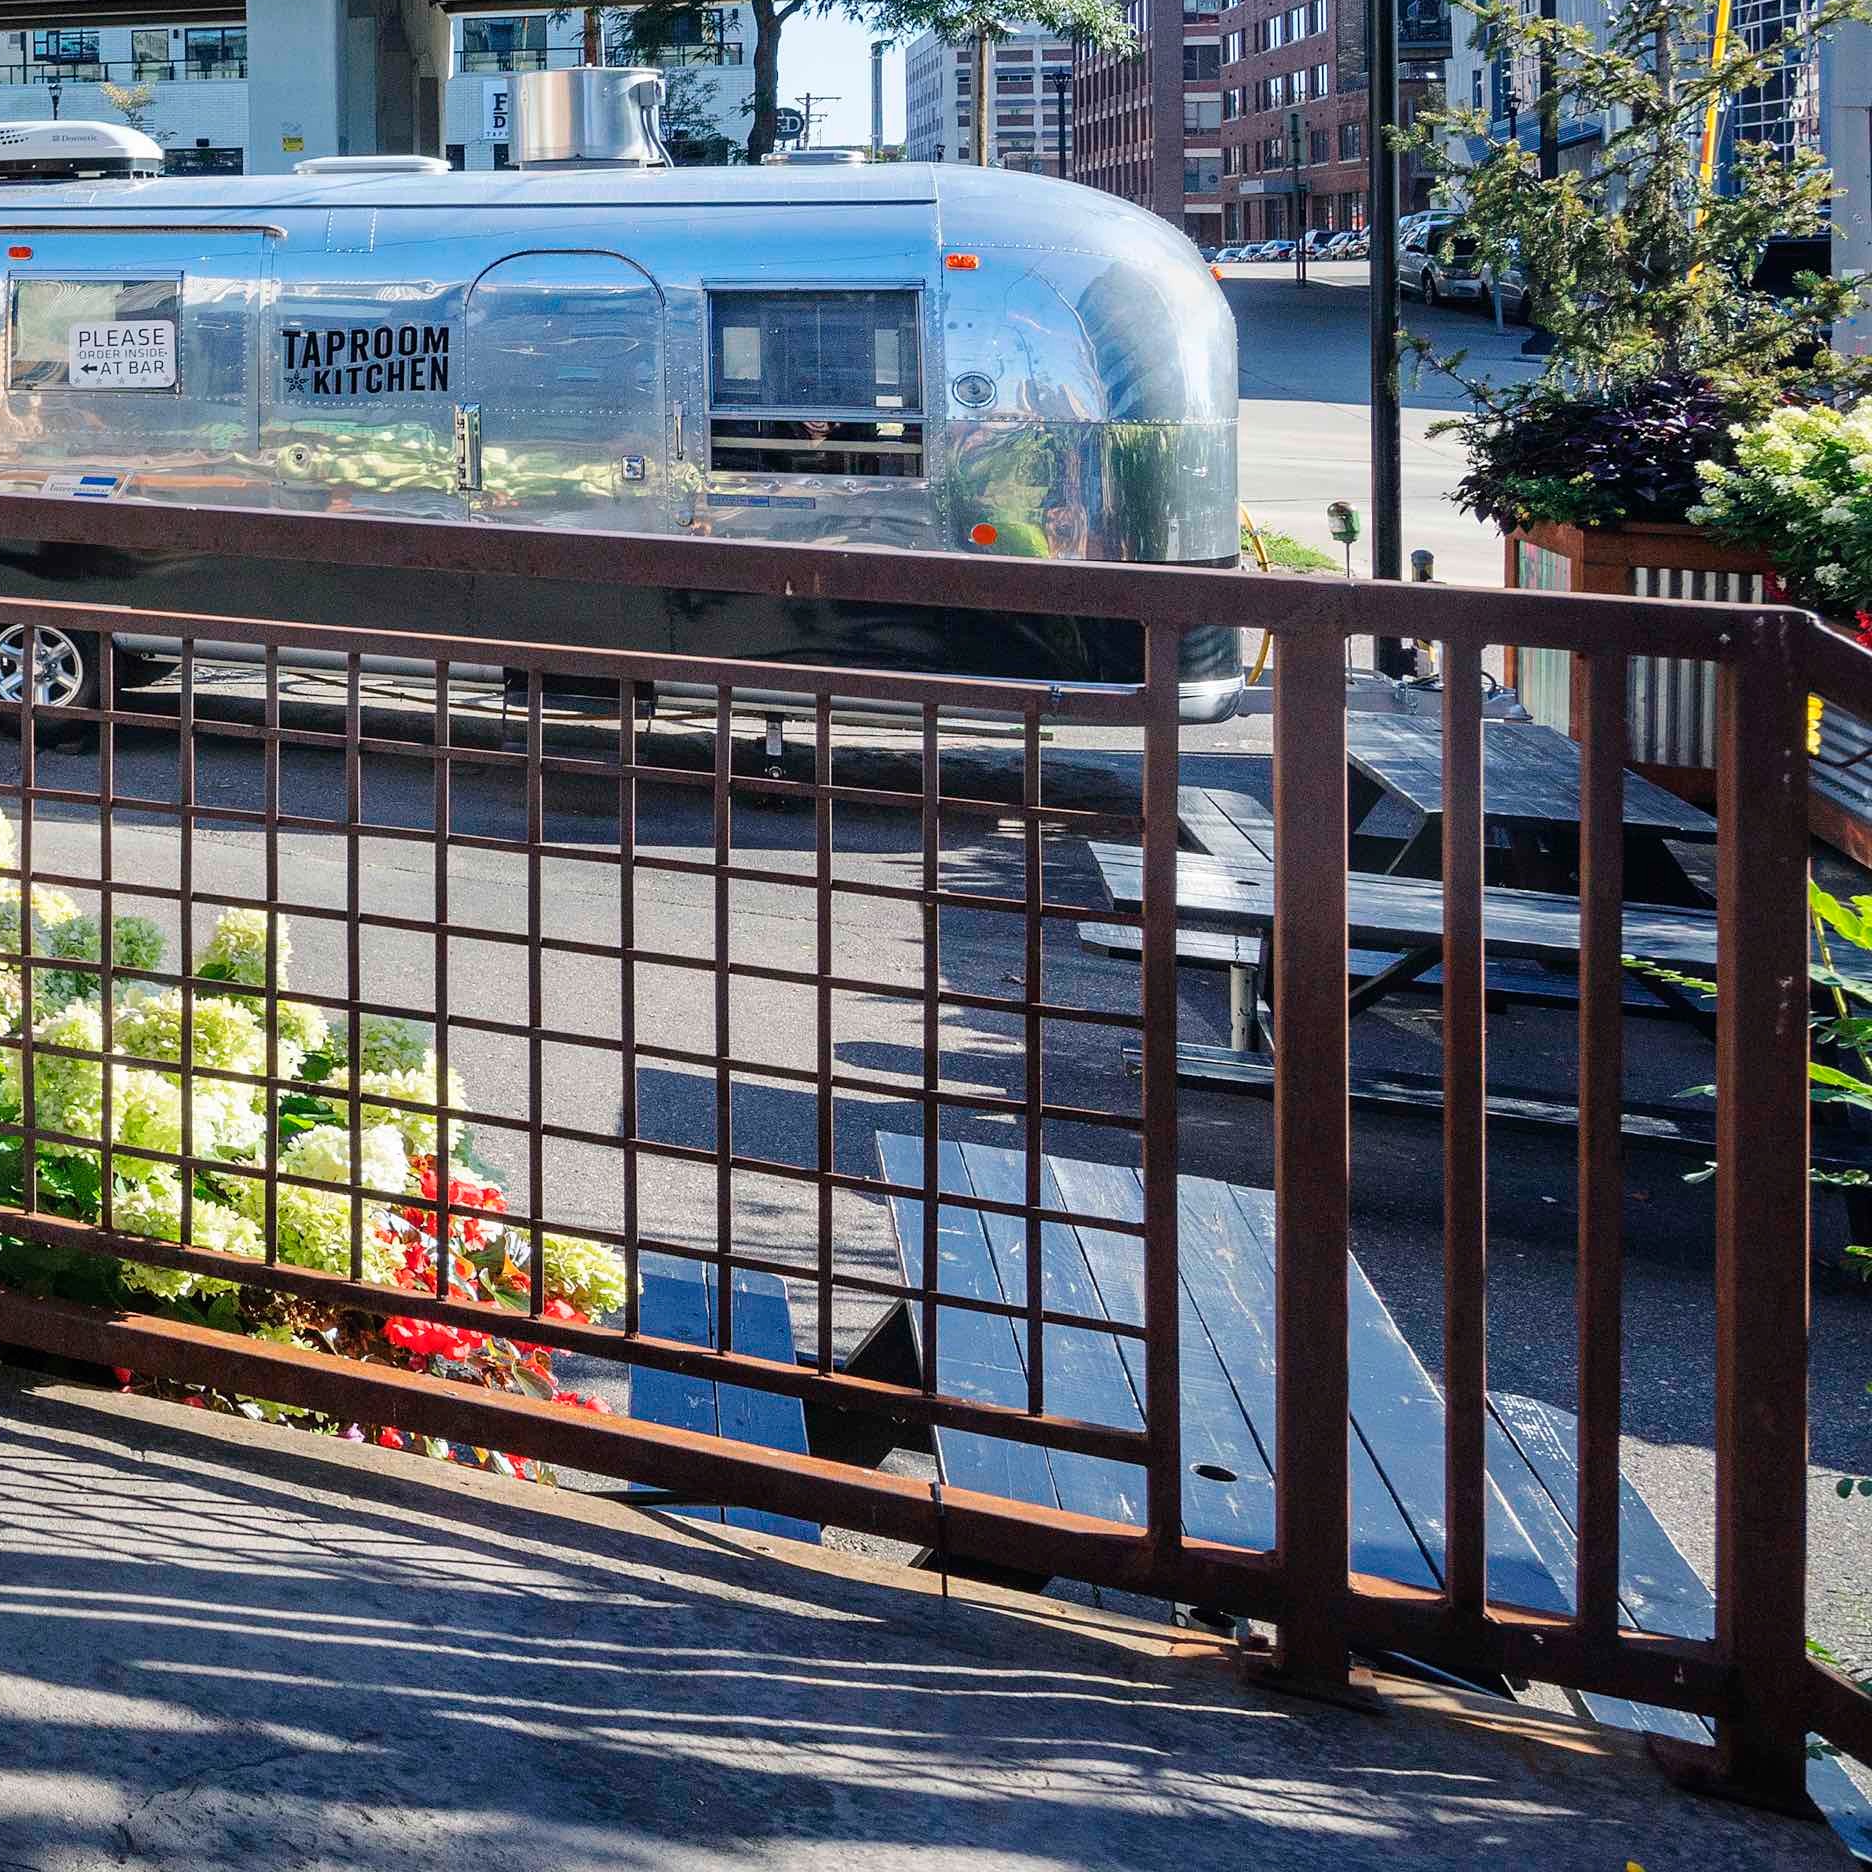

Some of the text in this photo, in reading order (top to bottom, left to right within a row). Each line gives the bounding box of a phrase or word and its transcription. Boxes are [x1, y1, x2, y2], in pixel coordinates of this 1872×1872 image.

[79, 328, 165, 347] PLEASE
[79, 348, 164, 359] ORDER INSIDE
[282, 326, 449, 369] TAPROOM
[100, 360, 165, 375] AT BAR
[313, 356, 449, 394] KITCHEN
